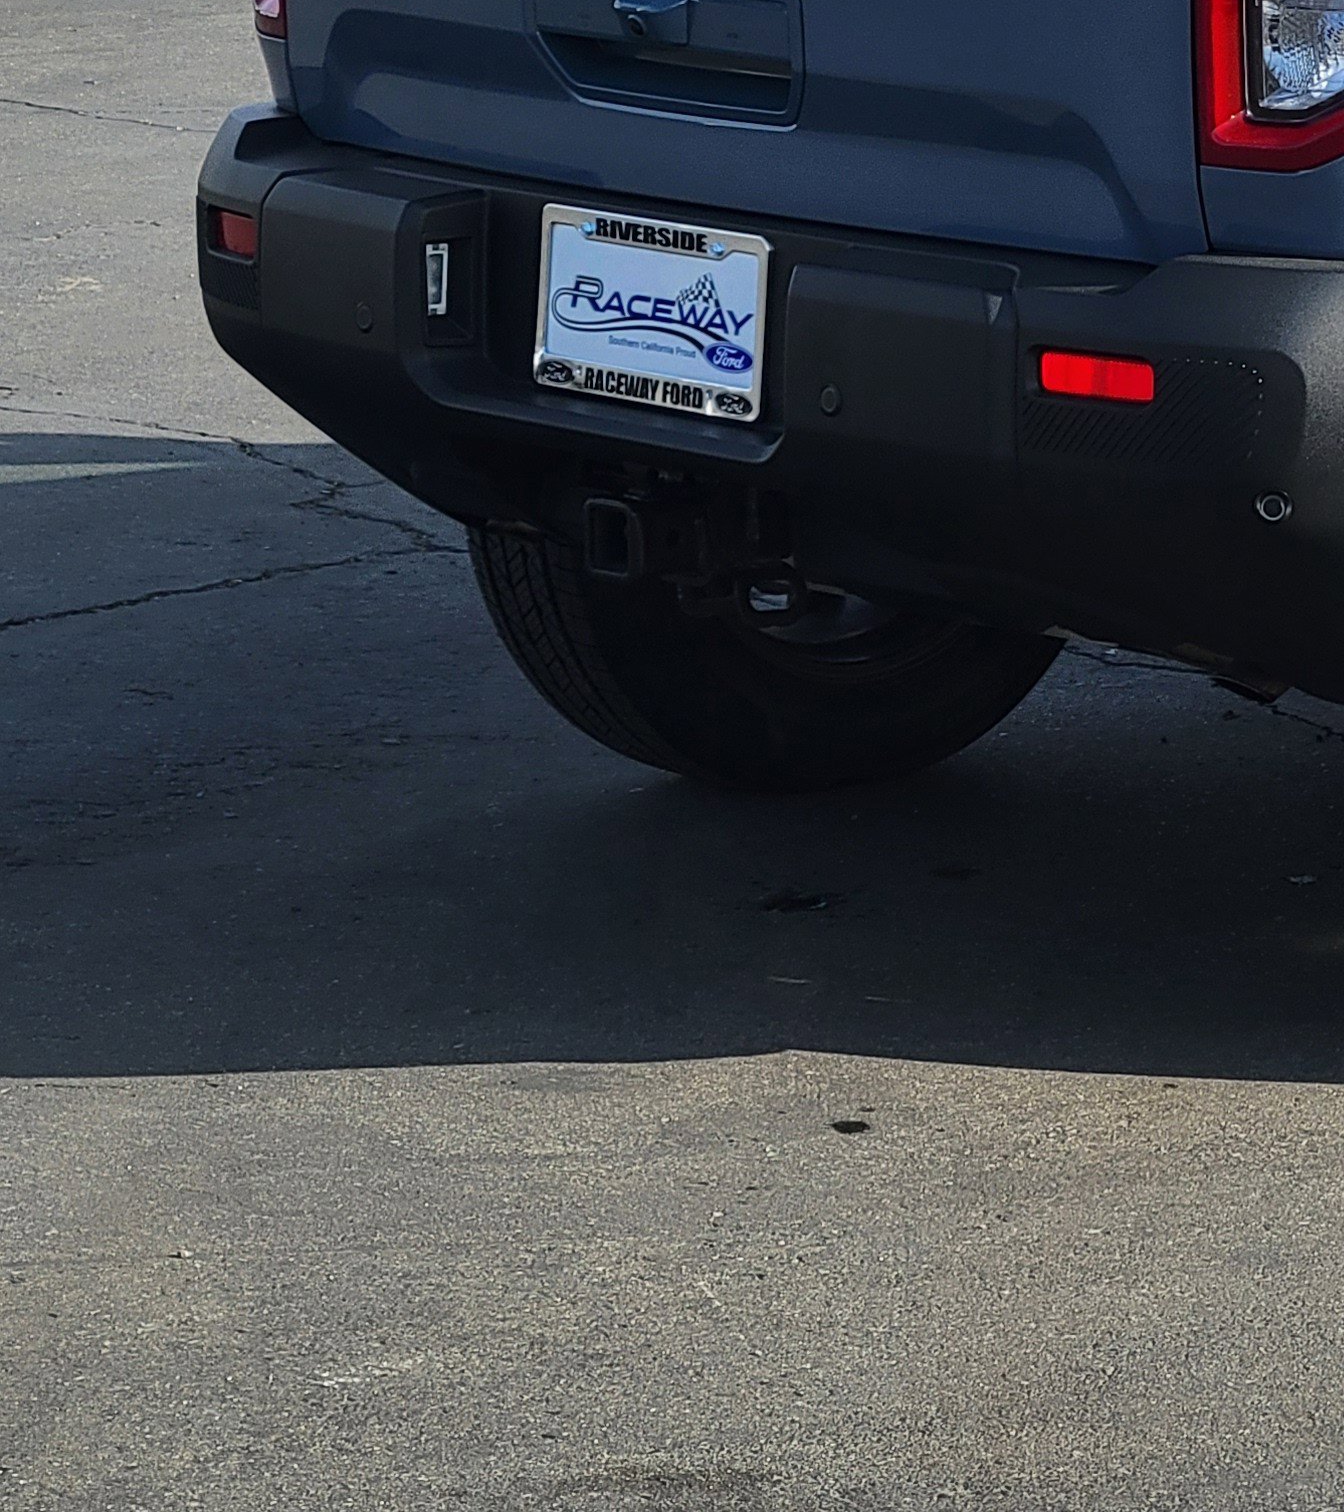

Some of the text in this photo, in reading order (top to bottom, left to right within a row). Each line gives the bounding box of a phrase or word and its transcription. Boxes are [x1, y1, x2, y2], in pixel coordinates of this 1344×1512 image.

[594, 217, 709, 254] RIVERSIDE
[569, 274, 754, 337] RACEWAY
[608, 334, 697, 359] Southern California Proud
[712, 346, 746, 369] Ford
[584, 366, 704, 410] RACEWAY FORD
